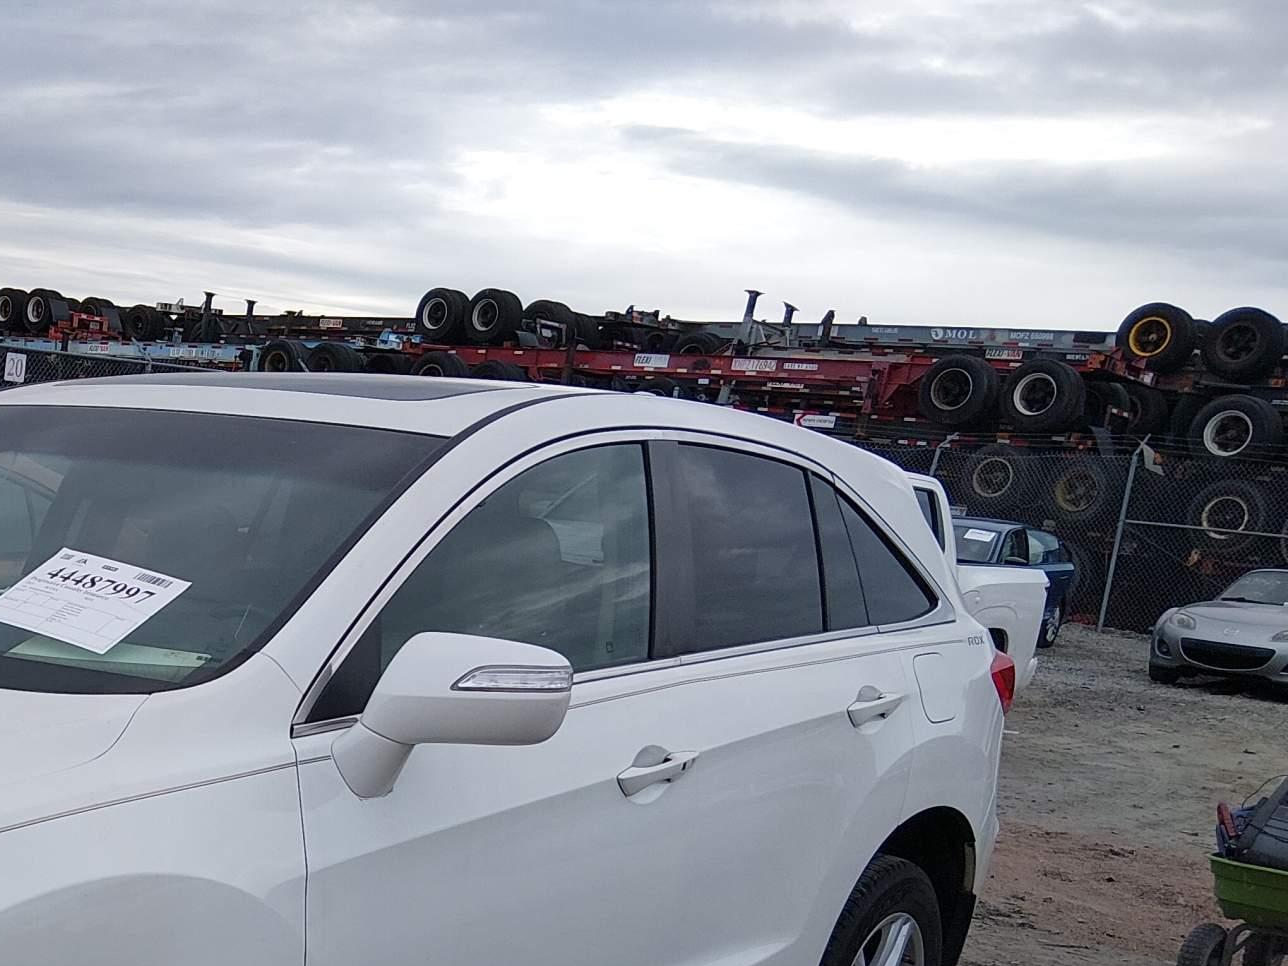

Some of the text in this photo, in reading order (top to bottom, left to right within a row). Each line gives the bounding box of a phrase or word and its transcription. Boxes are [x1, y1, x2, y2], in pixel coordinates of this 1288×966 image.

[944, 328, 977, 340] MOL
[7, 357, 24, 378] 20
[47, 566, 157, 605] 44487997
[967, 636, 985, 647] RDX
